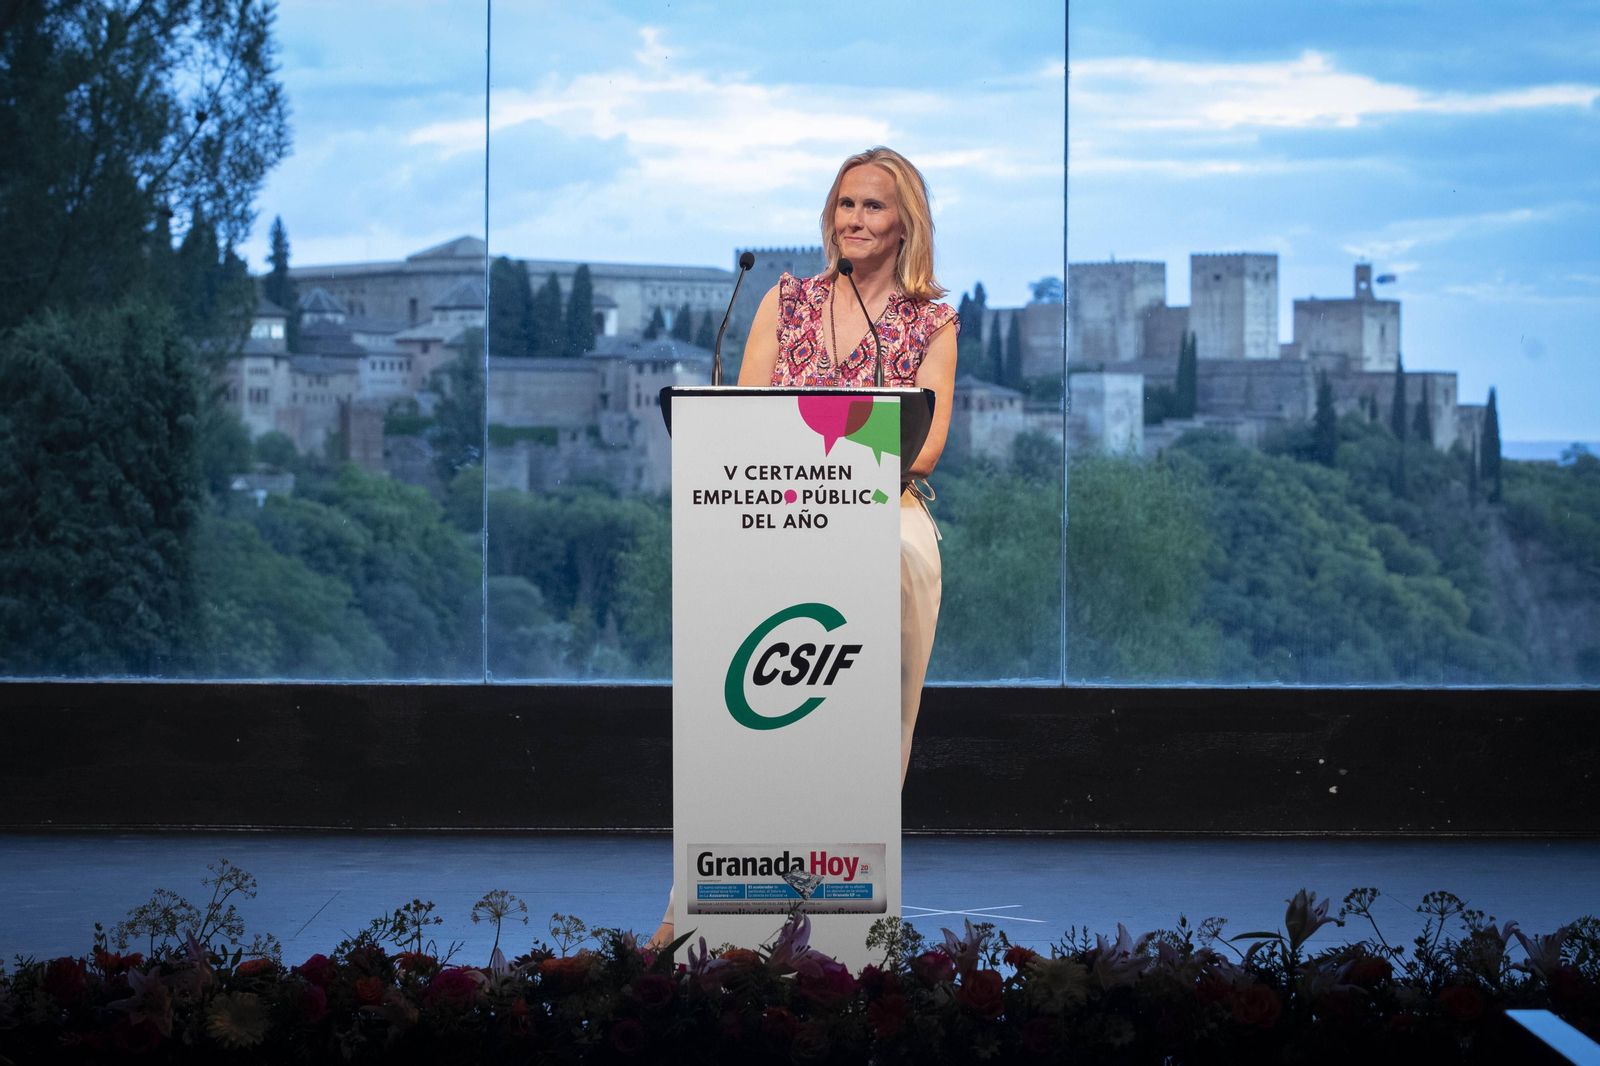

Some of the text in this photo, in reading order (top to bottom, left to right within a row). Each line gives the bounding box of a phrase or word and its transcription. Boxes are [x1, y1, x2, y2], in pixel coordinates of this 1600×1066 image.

[724, 465, 852, 480] V CERTAMEN
[742, 509, 828, 529] DEL AÑO
[752, 642, 864, 686] CSIF
[697, 851, 860, 882] Granada Hoy
